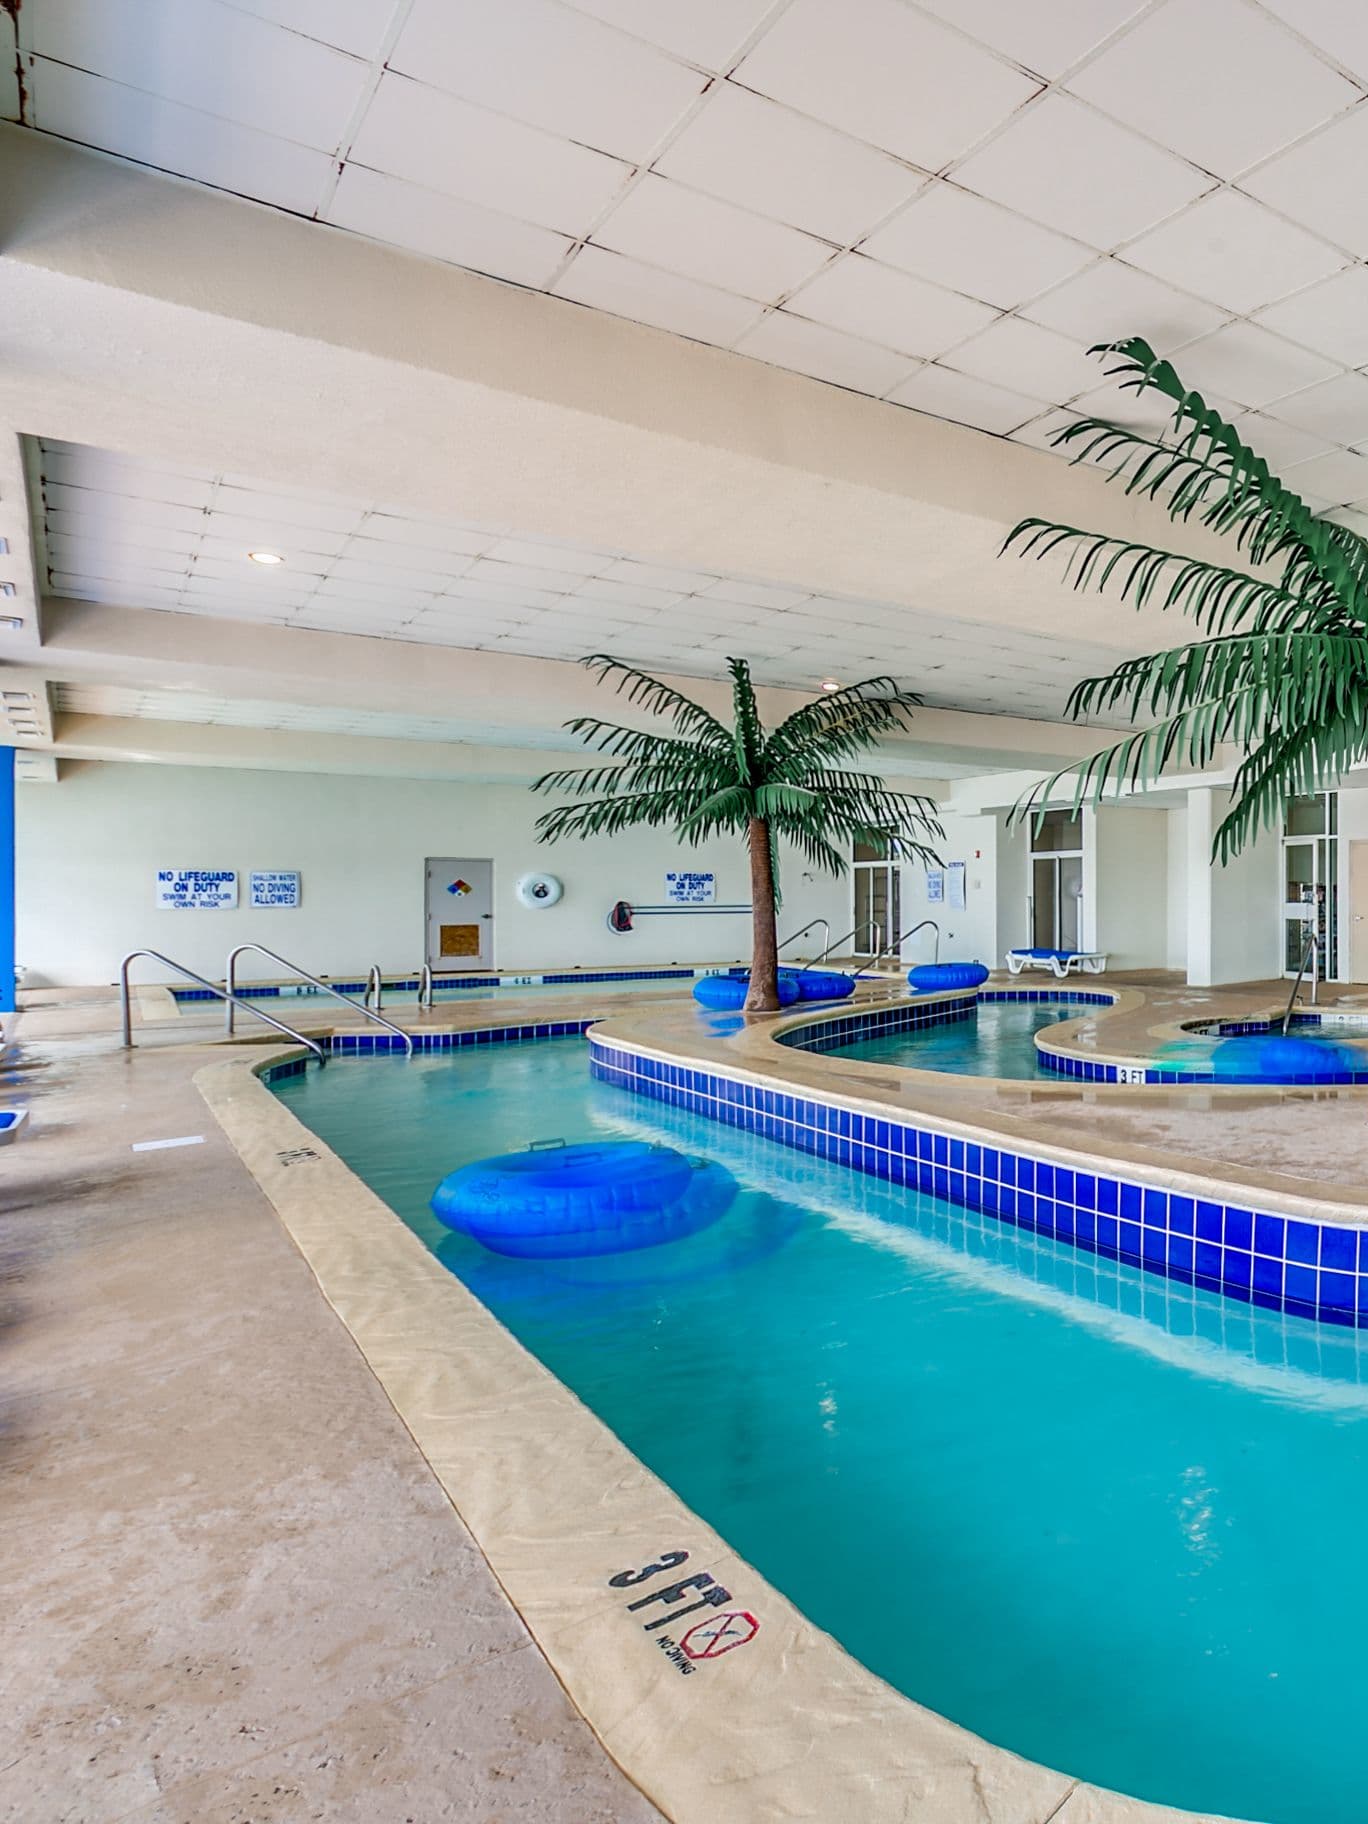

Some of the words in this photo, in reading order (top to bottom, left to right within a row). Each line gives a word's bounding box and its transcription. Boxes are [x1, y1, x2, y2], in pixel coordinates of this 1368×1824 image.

[158, 871, 174, 881] NO
[179, 871, 235, 881] LIFEGUARD
[173, 882, 188, 892] ON
[193, 882, 220, 892] DUTY
[253, 883, 265, 893] NO
[267, 883, 296, 893] DIVING
[163, 893, 187, 901] SWIM
[191, 893, 202, 901] AT
[207, 893, 231, 901] YOUR
[254, 893, 296, 904] ALLOWED
[200, 900, 220, 908] RISK
[1120, 1069, 1127, 1084] 3
[1131, 1070, 1143, 1084] FT
[608, 1551, 689, 1588] 3
[627, 1572, 733, 1632] FT
[656, 1634, 675, 1649] NO
[666, 1645, 697, 1675] DIVING
